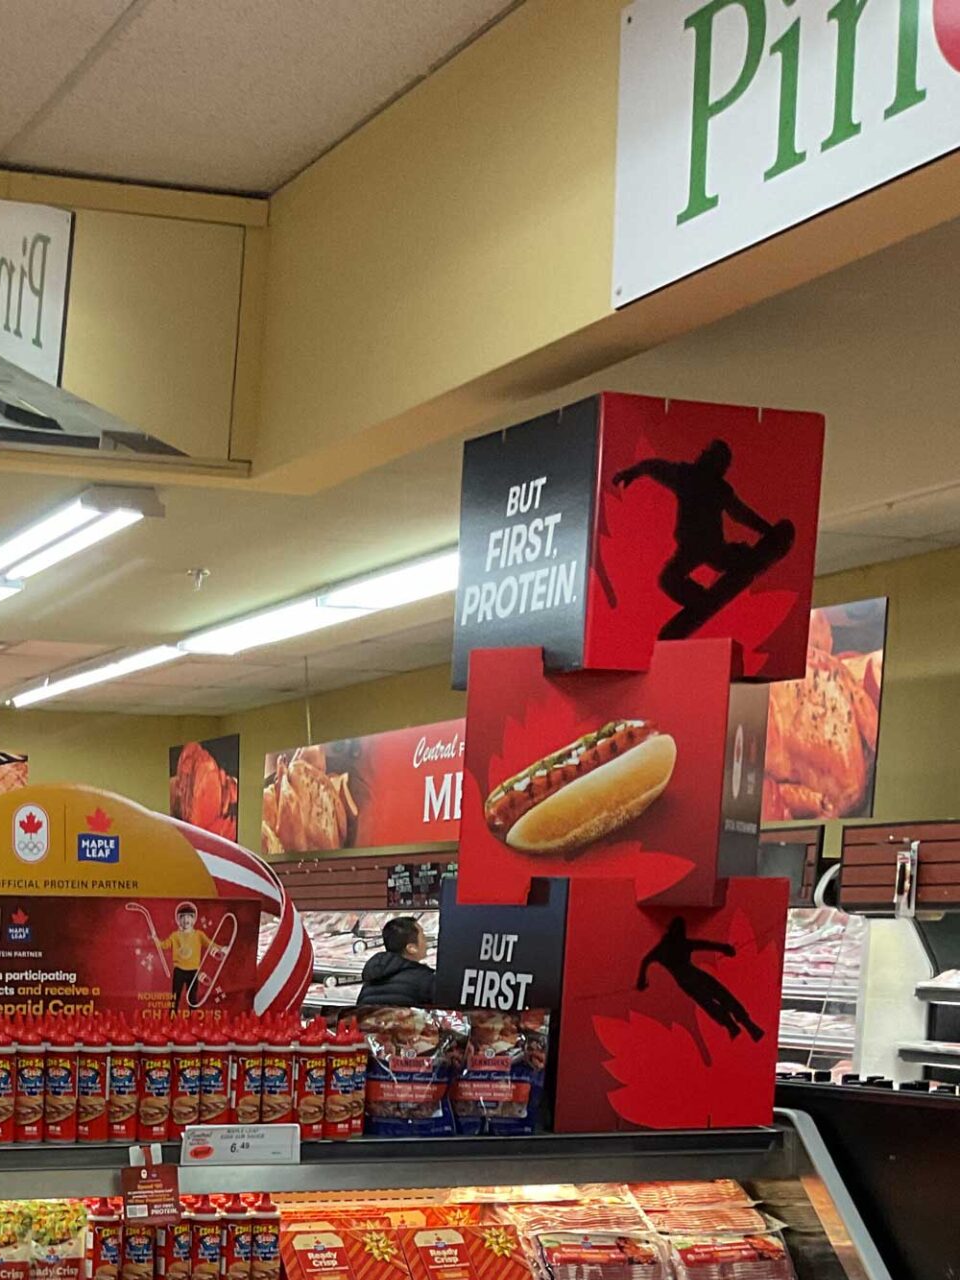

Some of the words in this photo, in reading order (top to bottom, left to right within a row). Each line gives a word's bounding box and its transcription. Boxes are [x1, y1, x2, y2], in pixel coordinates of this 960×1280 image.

[677, 0, 960, 225] Pin
[506, 477, 546, 518] BUT
[485, 513, 562, 573] FIRST,
[461, 561, 578, 626] PROTEIN.
[413, 733, 458, 768] Central
[81, 839, 115, 850] MAPLE
[85, 847, 111, 858] LEAF
[43, 879, 89, 889] PROTEIN
[91, 880, 139, 890] PARTNER
[480, 933, 518, 962] BUT
[5, 969, 77, 983] participating
[17, 984, 41, 996] and
[45, 984, 89, 996] receive
[92, 986, 100, 996] a
[137, 992, 177, 1000] NOURISH
[230, 1142, 250, 1153] 6.49
[307, 1251, 337, 1261] Ready
[430, 1248, 458, 1258] Ready
[312, 1258, 338, 1268] Crisp
[434, 1255, 459, 1264] Crisp
[1, 1268, 24, 1280] Crisp
